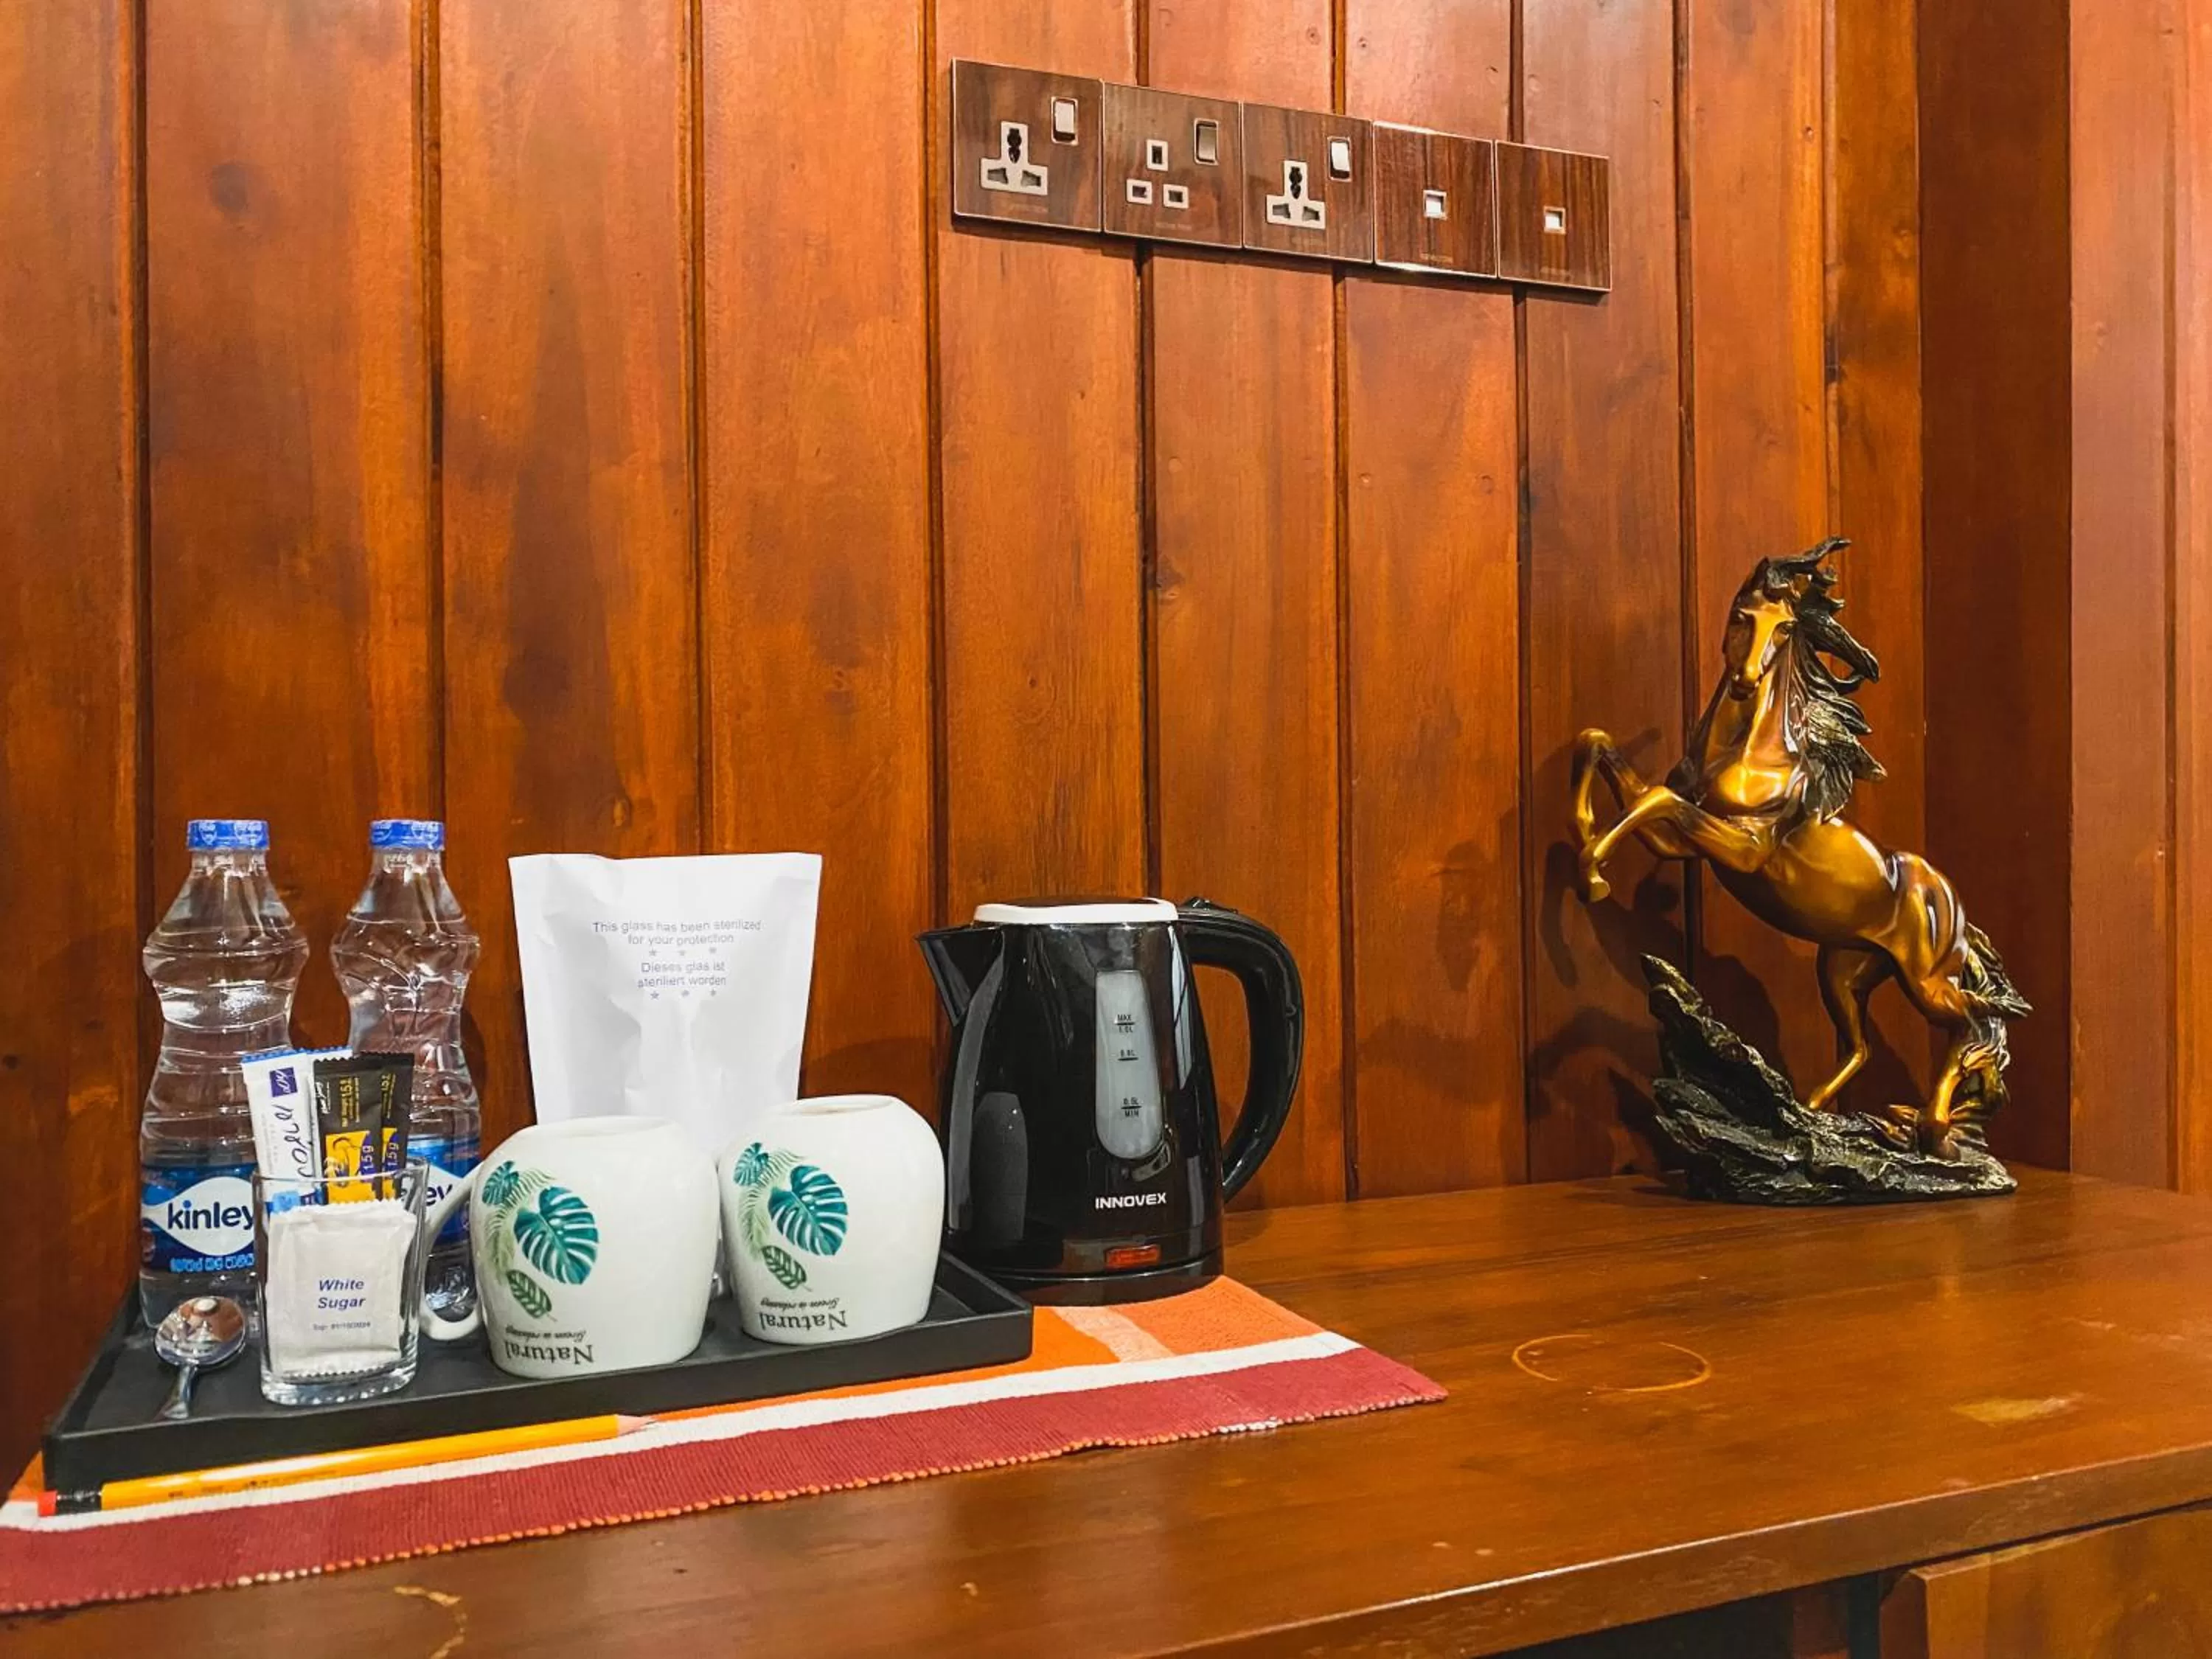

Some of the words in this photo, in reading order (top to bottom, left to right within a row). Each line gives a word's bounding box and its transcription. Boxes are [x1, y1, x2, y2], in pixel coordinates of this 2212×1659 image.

[592, 922, 618, 933] This
[621, 920, 654, 934] glass
[656, 922, 677, 933] has
[681, 922, 709, 933] been
[713, 919, 761, 931] sterilized
[627, 934, 644, 945] for
[648, 936, 674, 946] your
[676, 933, 734, 946] protection
[641, 961, 681, 973] Dieses
[685, 961, 709, 974] glas
[689, 975, 726, 987] worden
[1124, 1110, 1139, 1118] MIN
[1095, 1192, 1167, 1210] INNOVEX
[167, 1200, 254, 1231] kinley
[319, 1279, 365, 1292] White
[318, 1297, 366, 1312] Sugar
[759, 1310, 848, 1331] Natural
[504, 1340, 594, 1364] Natural
